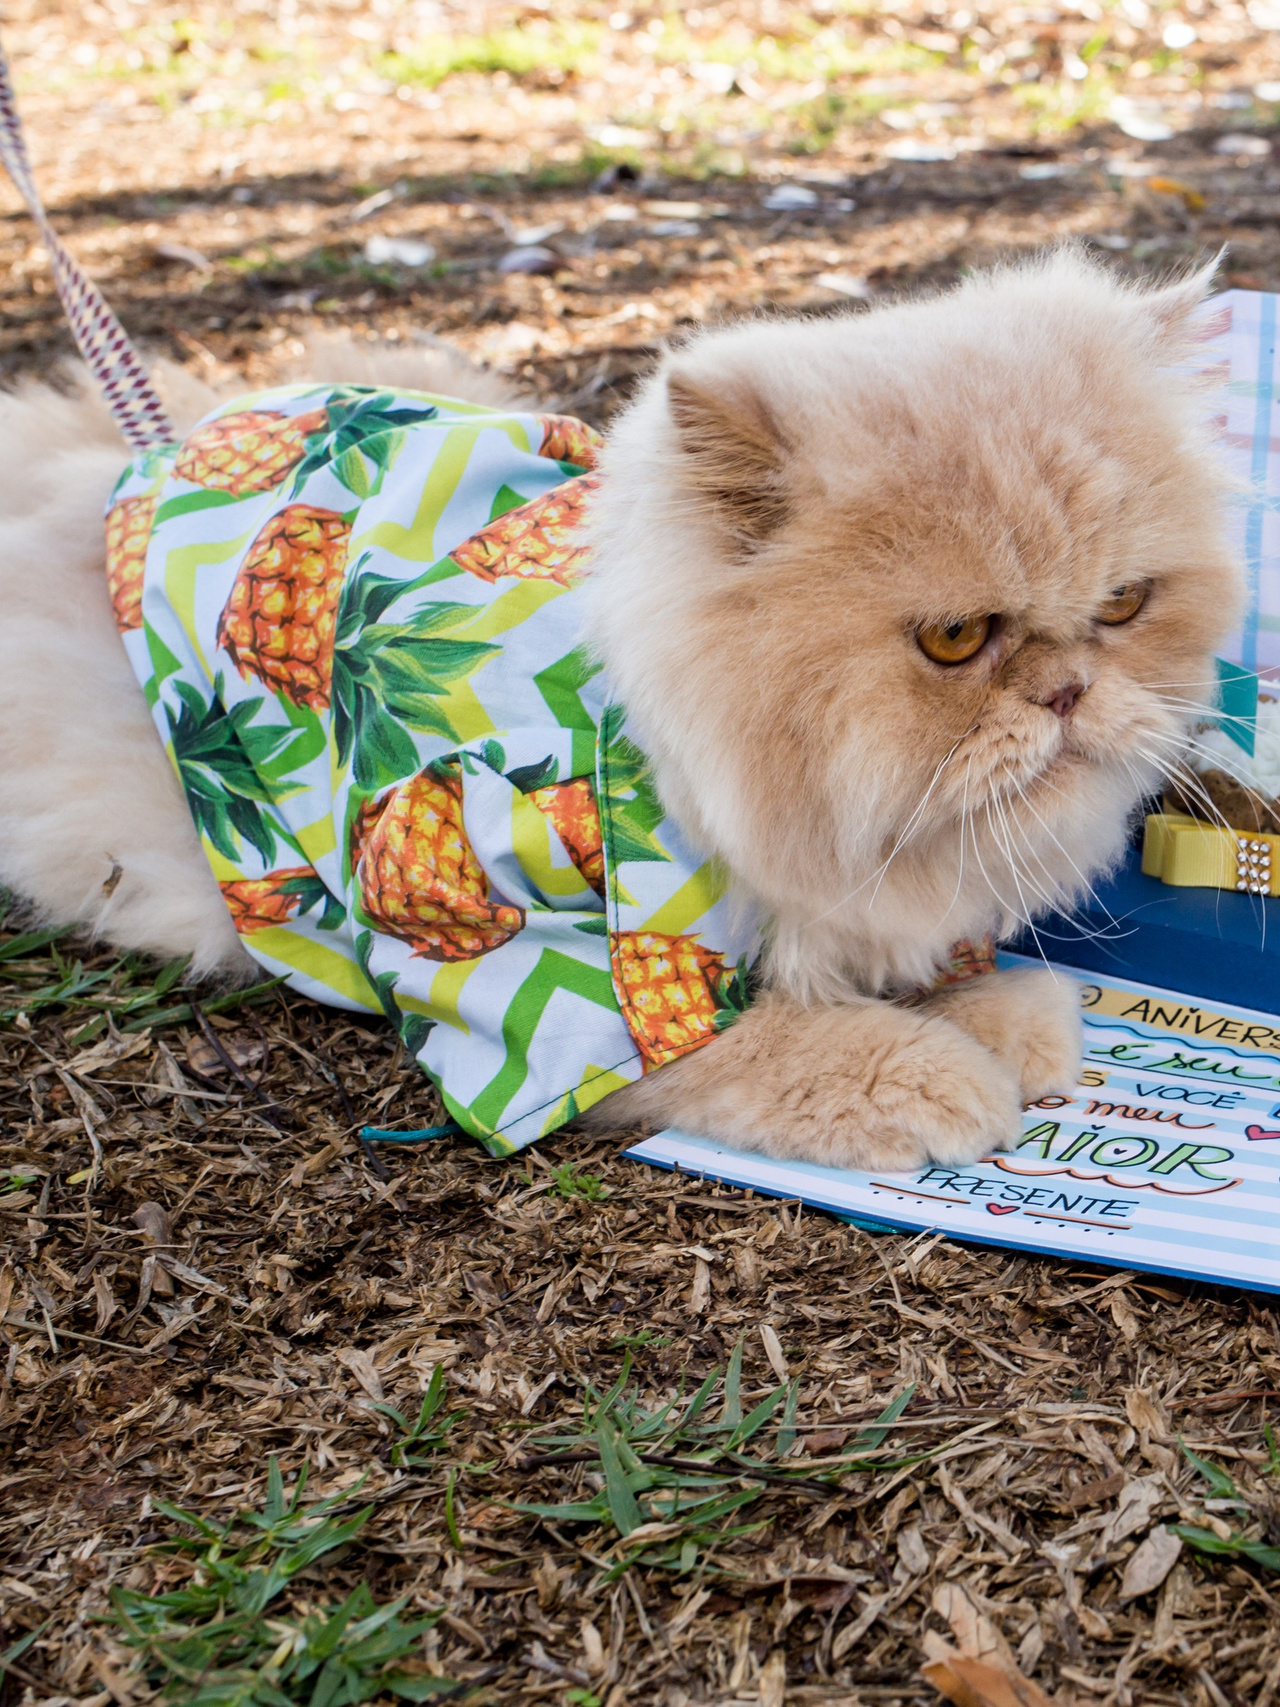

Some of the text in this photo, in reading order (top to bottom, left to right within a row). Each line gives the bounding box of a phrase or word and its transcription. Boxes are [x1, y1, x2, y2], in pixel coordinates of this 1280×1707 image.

[1089, 1100, 1216, 1130] meu
[1136, 1083, 1247, 1110] VOCÊ
[997, 1121, 1235, 1181] AIOR
[916, 1168, 1140, 1218] PRESENTE
